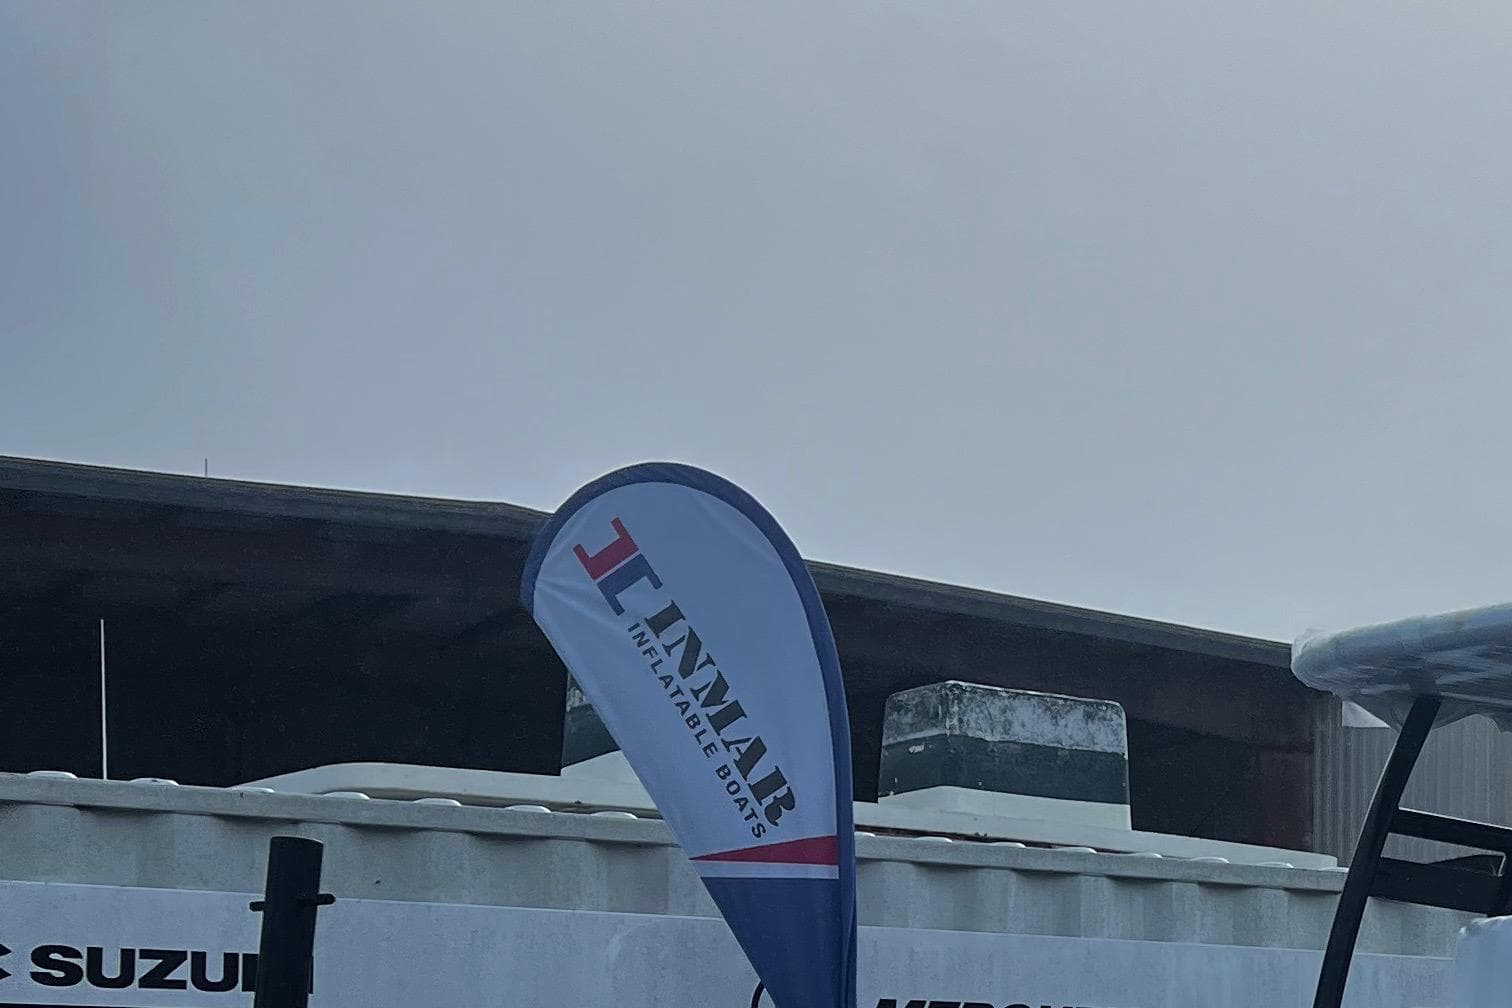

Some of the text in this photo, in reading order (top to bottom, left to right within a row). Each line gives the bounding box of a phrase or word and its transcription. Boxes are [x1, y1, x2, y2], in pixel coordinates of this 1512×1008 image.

[628, 622, 766, 839] INFLATABLE BOATS
[644, 600, 796, 827] INMAR
[30, 945, 313, 993] SUZU
